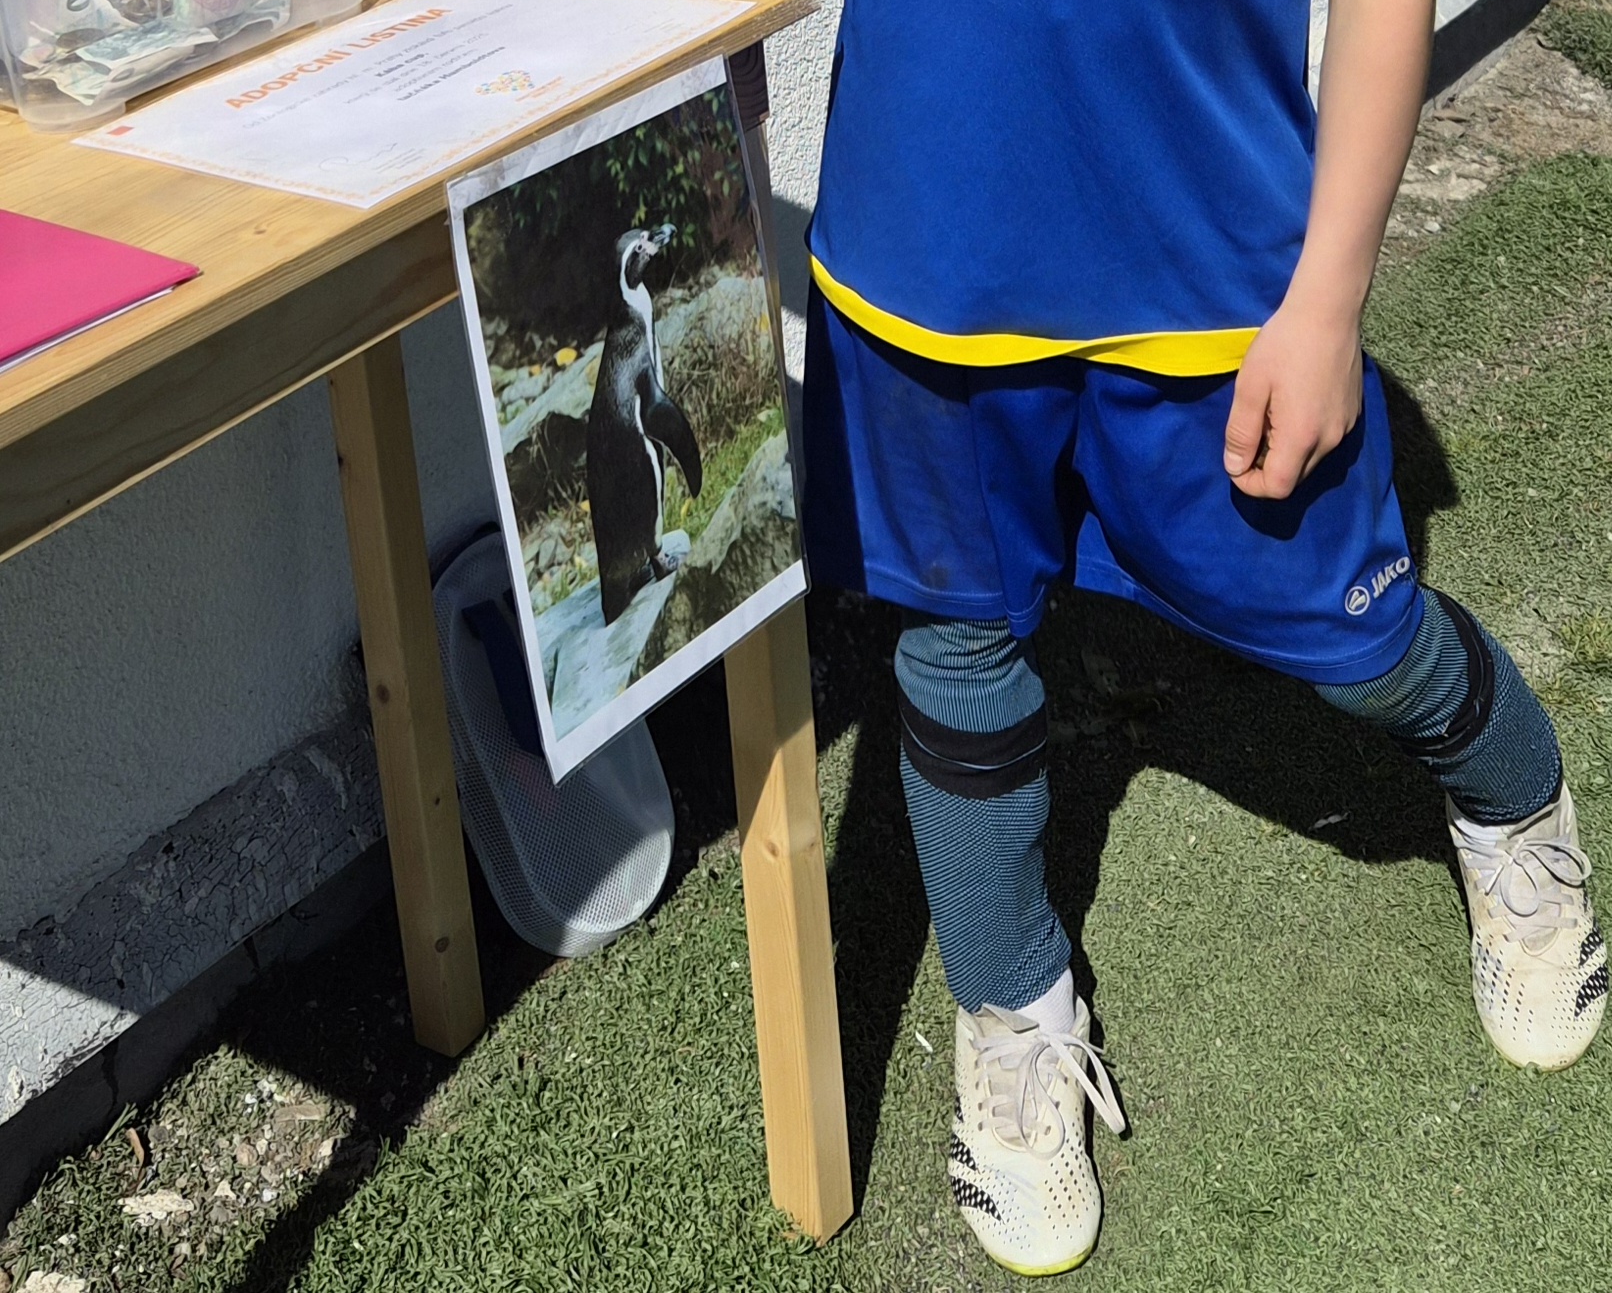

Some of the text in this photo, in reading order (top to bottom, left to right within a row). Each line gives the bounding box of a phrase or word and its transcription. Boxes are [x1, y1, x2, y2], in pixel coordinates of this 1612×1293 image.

[225, 48, 352, 108] ADOPČNÍ
[345, 8, 453, 48] LISTINA
[1371, 556, 1411, 599] JAKO
